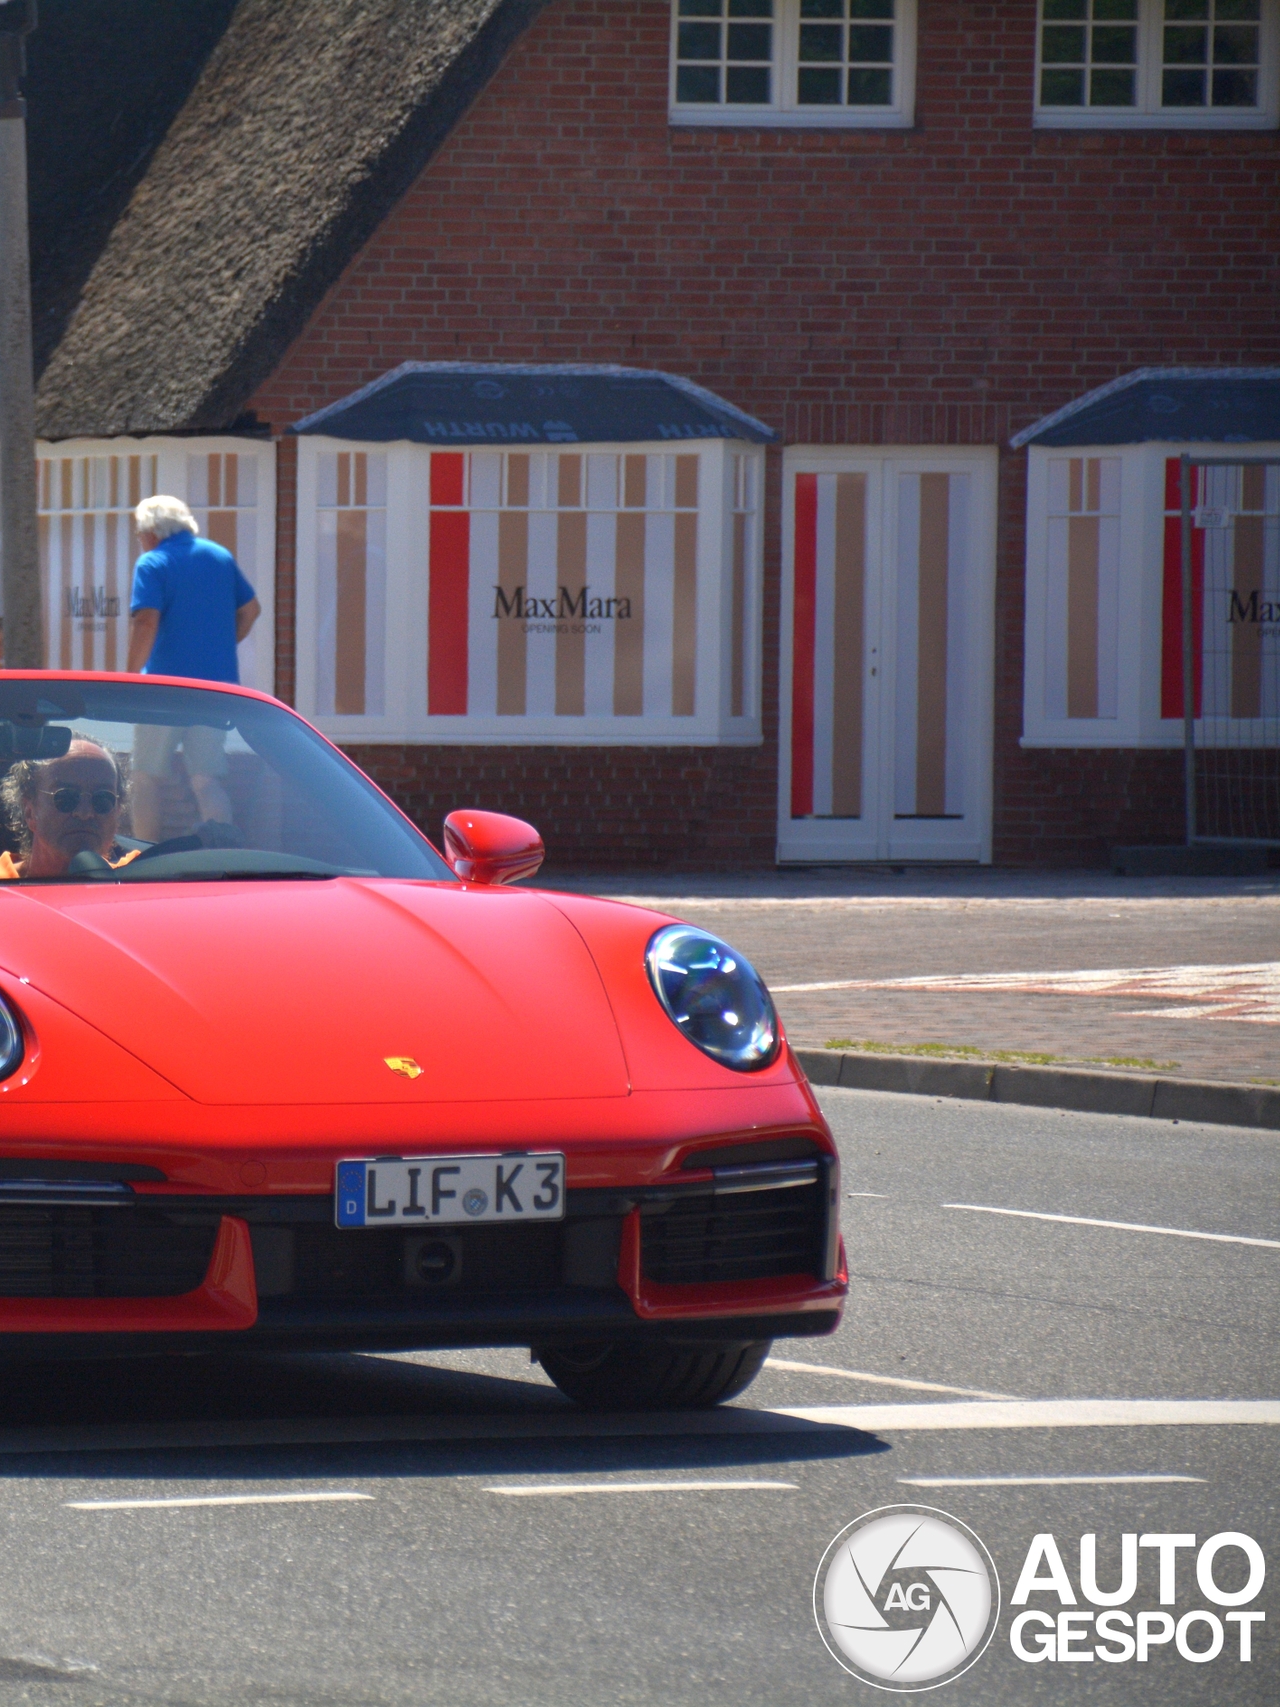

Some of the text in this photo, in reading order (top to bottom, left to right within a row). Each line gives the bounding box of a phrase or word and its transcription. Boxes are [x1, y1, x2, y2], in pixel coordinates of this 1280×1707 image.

[491, 586, 632, 619] MaxMara
[522, 624, 601, 634] OPENING SOON
[367, 1166, 461, 1217] LIF
[346, 1201, 357, 1215] D
